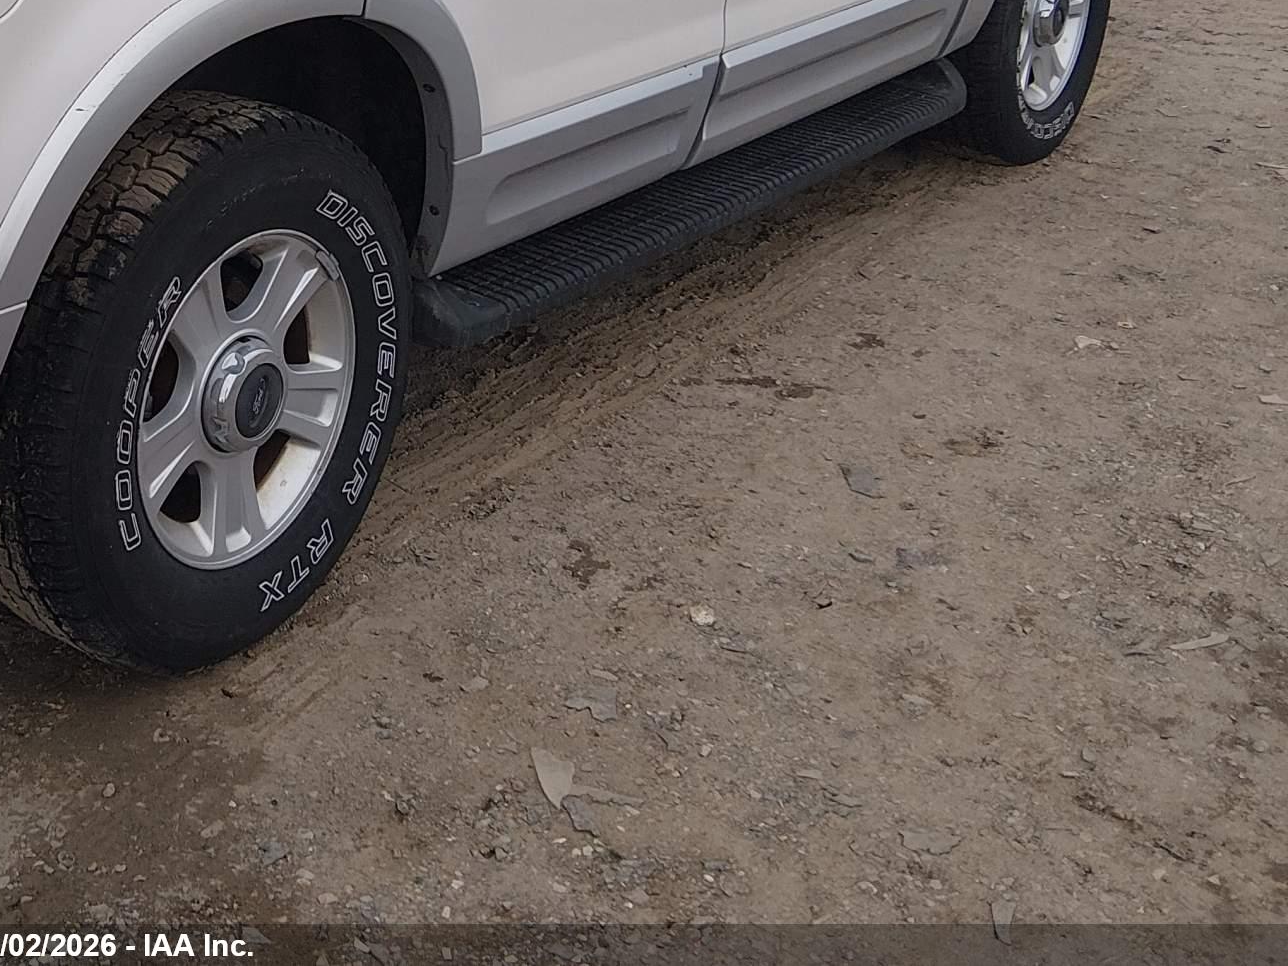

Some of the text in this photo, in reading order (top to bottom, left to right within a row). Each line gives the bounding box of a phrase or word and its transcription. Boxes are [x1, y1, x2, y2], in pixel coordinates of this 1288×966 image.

[115, 276, 182, 551] COOPER
[258, 189, 398, 613] DISCOVERER RTX
